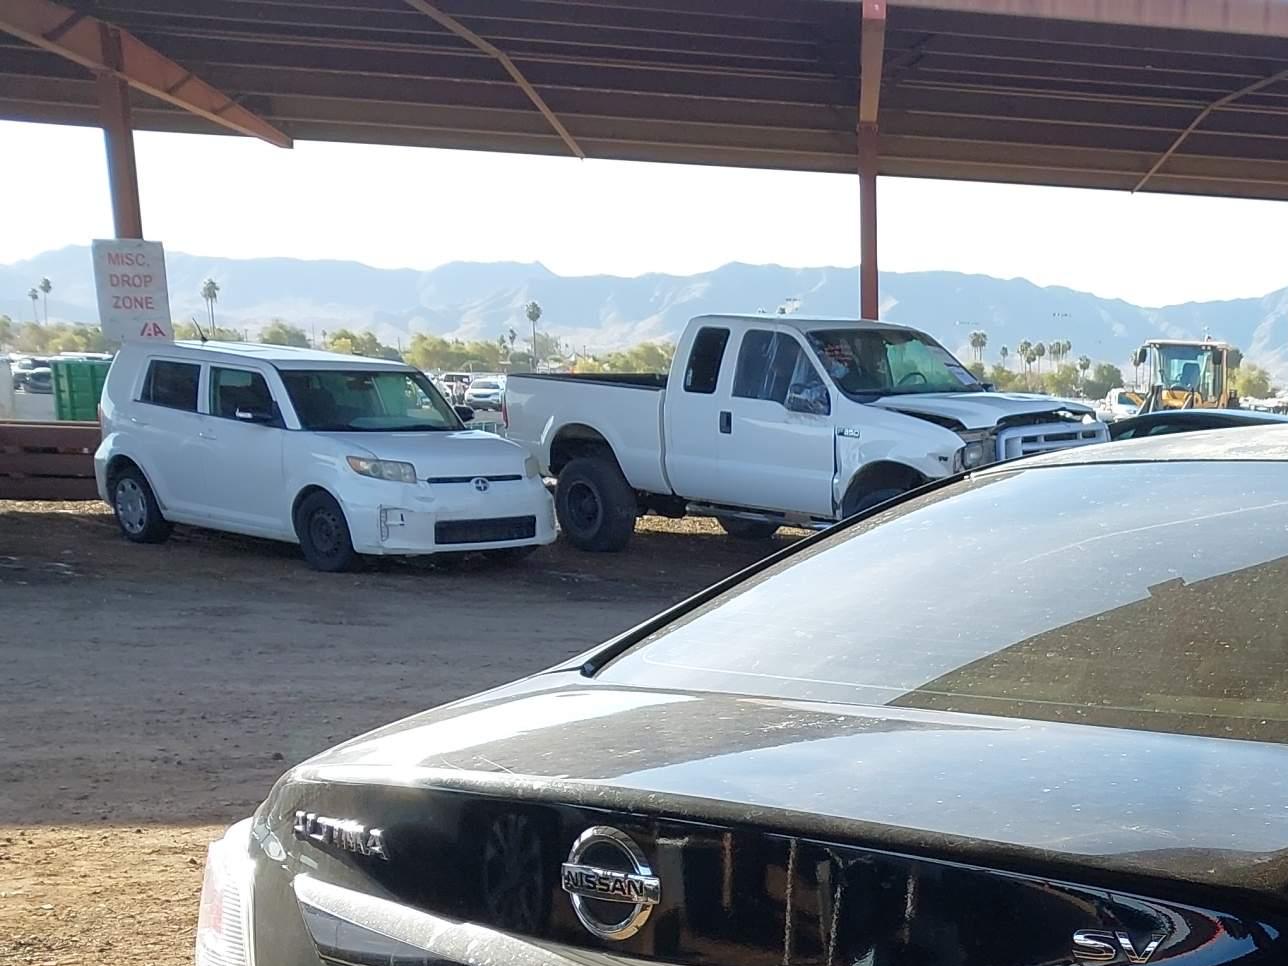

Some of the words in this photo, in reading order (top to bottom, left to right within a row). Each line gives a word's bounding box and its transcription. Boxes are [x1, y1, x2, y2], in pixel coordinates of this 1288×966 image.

[106, 252, 150, 267] MISC.
[109, 274, 153, 288] DROP
[112, 296, 155, 310] ZONE
[566, 869, 644, 897] NISSAN
[1071, 929, 1168, 964] SV
